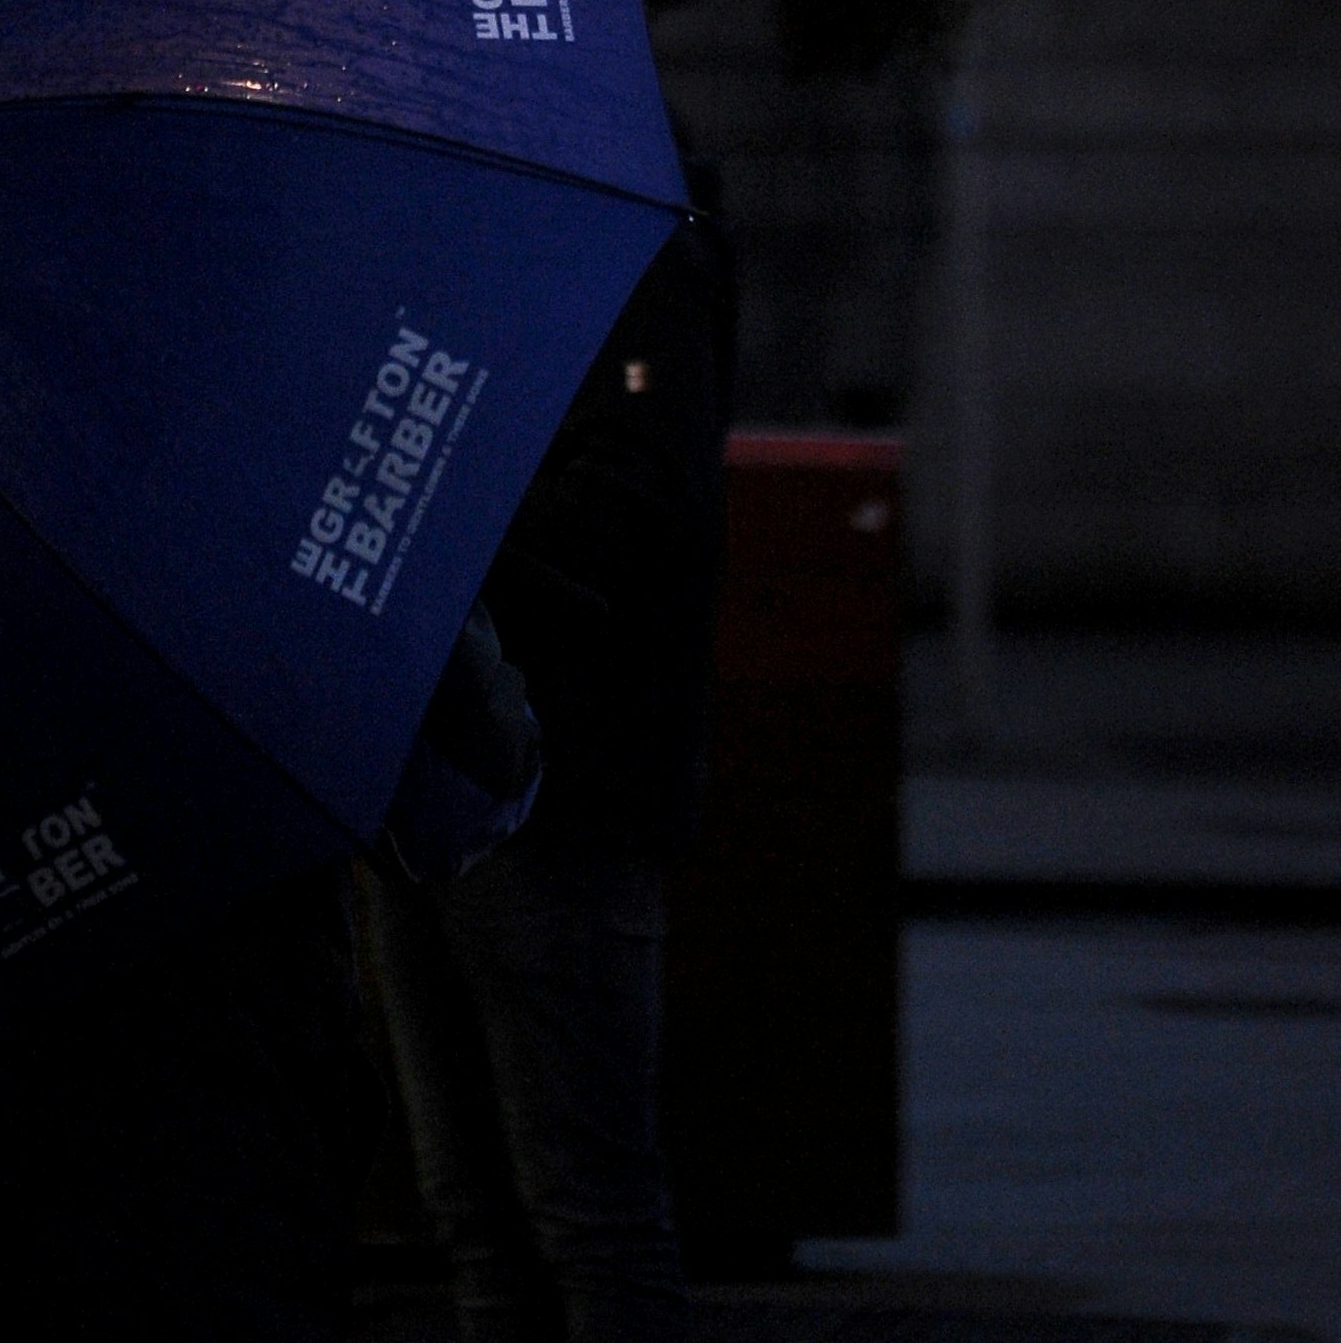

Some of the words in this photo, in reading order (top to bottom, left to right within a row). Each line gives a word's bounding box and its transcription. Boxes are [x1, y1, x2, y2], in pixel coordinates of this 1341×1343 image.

[473, 13, 558, 41] THE
[343, 350, 470, 564] BARBER
[289, 538, 369, 607] THE
